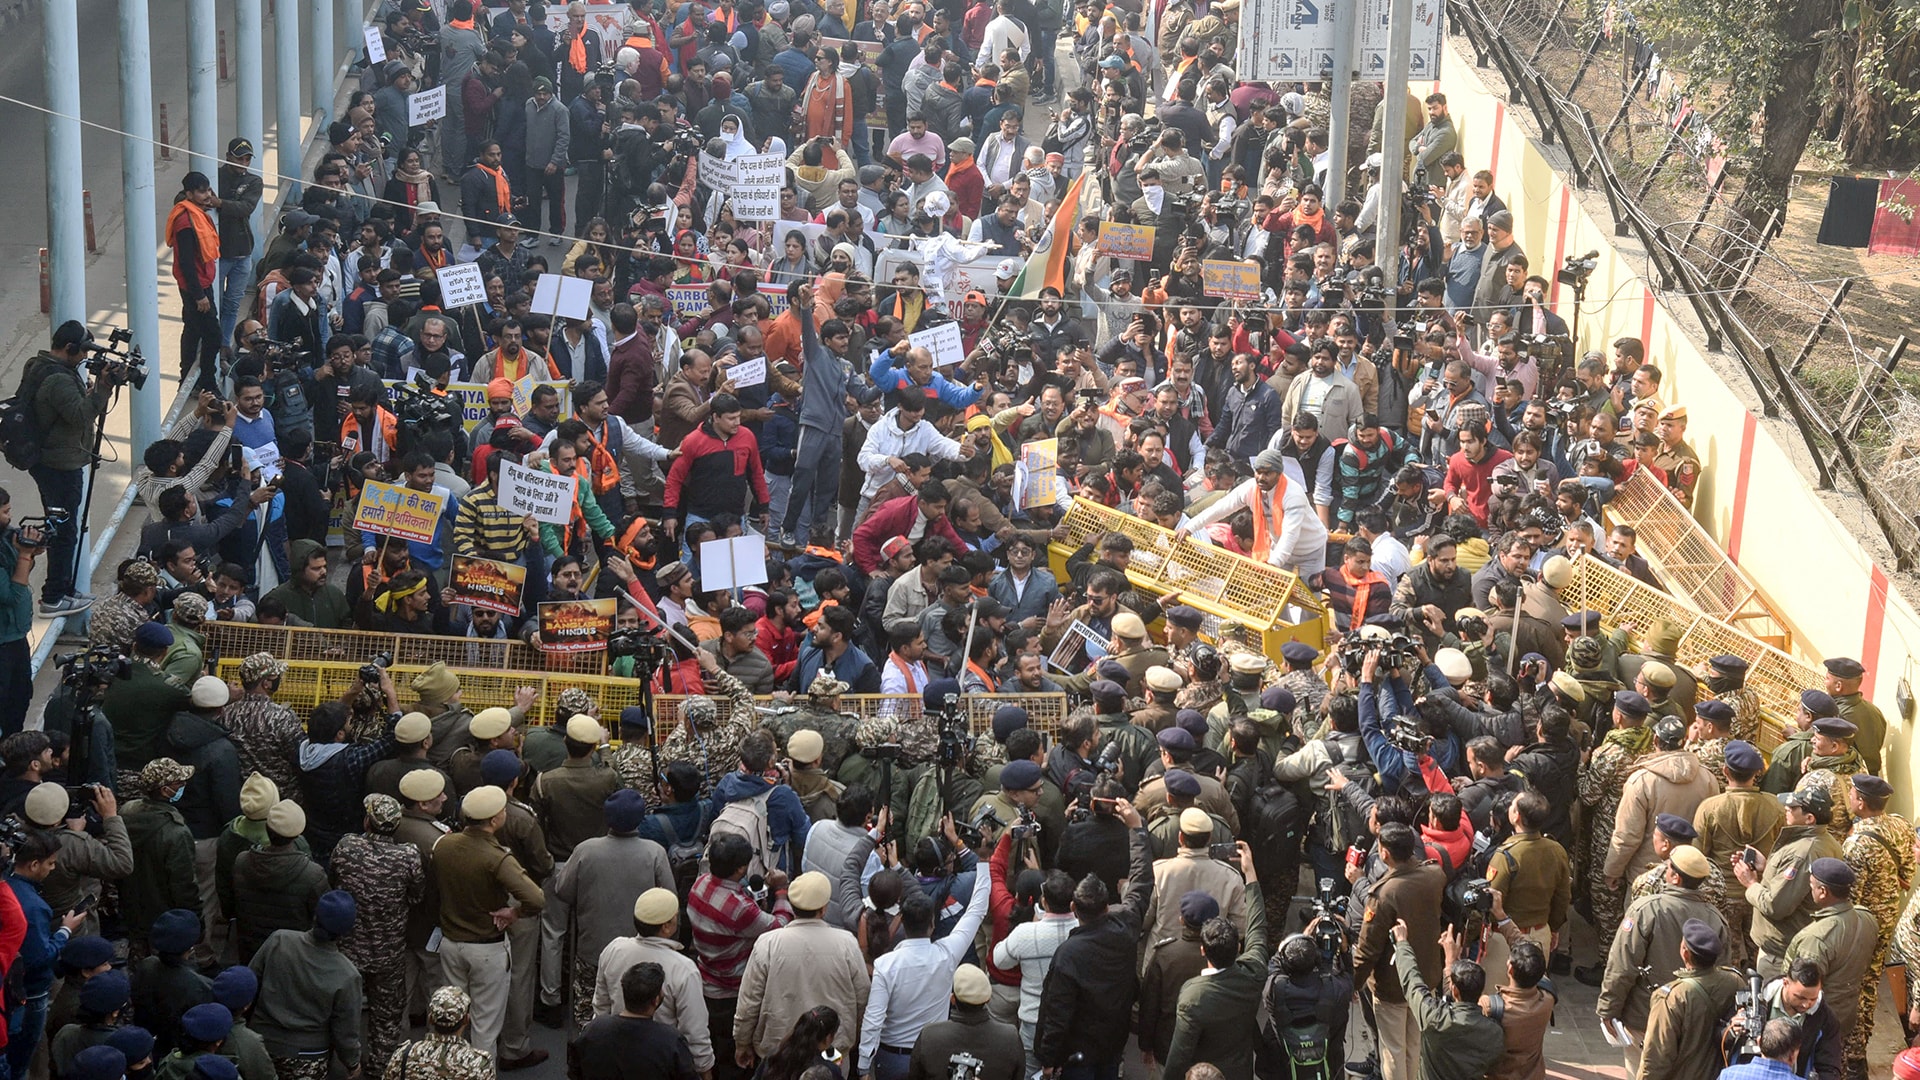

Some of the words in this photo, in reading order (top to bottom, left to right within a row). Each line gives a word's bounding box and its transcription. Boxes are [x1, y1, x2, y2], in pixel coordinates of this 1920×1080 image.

[748, 190, 754, 200] के
[771, 189, 777, 200] को
[508, 466, 517, 481] दीपू
[517, 471, 524, 480] का
[524, 472, 544, 486] बलिदान
[545, 477, 558, 489] रहेगा
[366, 484, 382, 506] हिंदू
[406, 494, 419, 509] की
[421, 499, 437, 516] रक्षा,
[515, 484, 526, 496] न्याय
[527, 486, 532, 497] के
[532, 488, 544, 501] लिए
[554, 492, 559, 504] है
[513, 496, 527, 510] दिल्ली
[527, 502, 534, 514] की
[362, 506, 385, 520] हमारी
[386, 510, 433, 531] प्राथमिकता!
[457, 574, 517, 592] BANGLADESH
[468, 583, 504, 596] HINDUS
[546, 619, 610, 630] BANGLADESH
[558, 627, 597, 636] HINDUS
